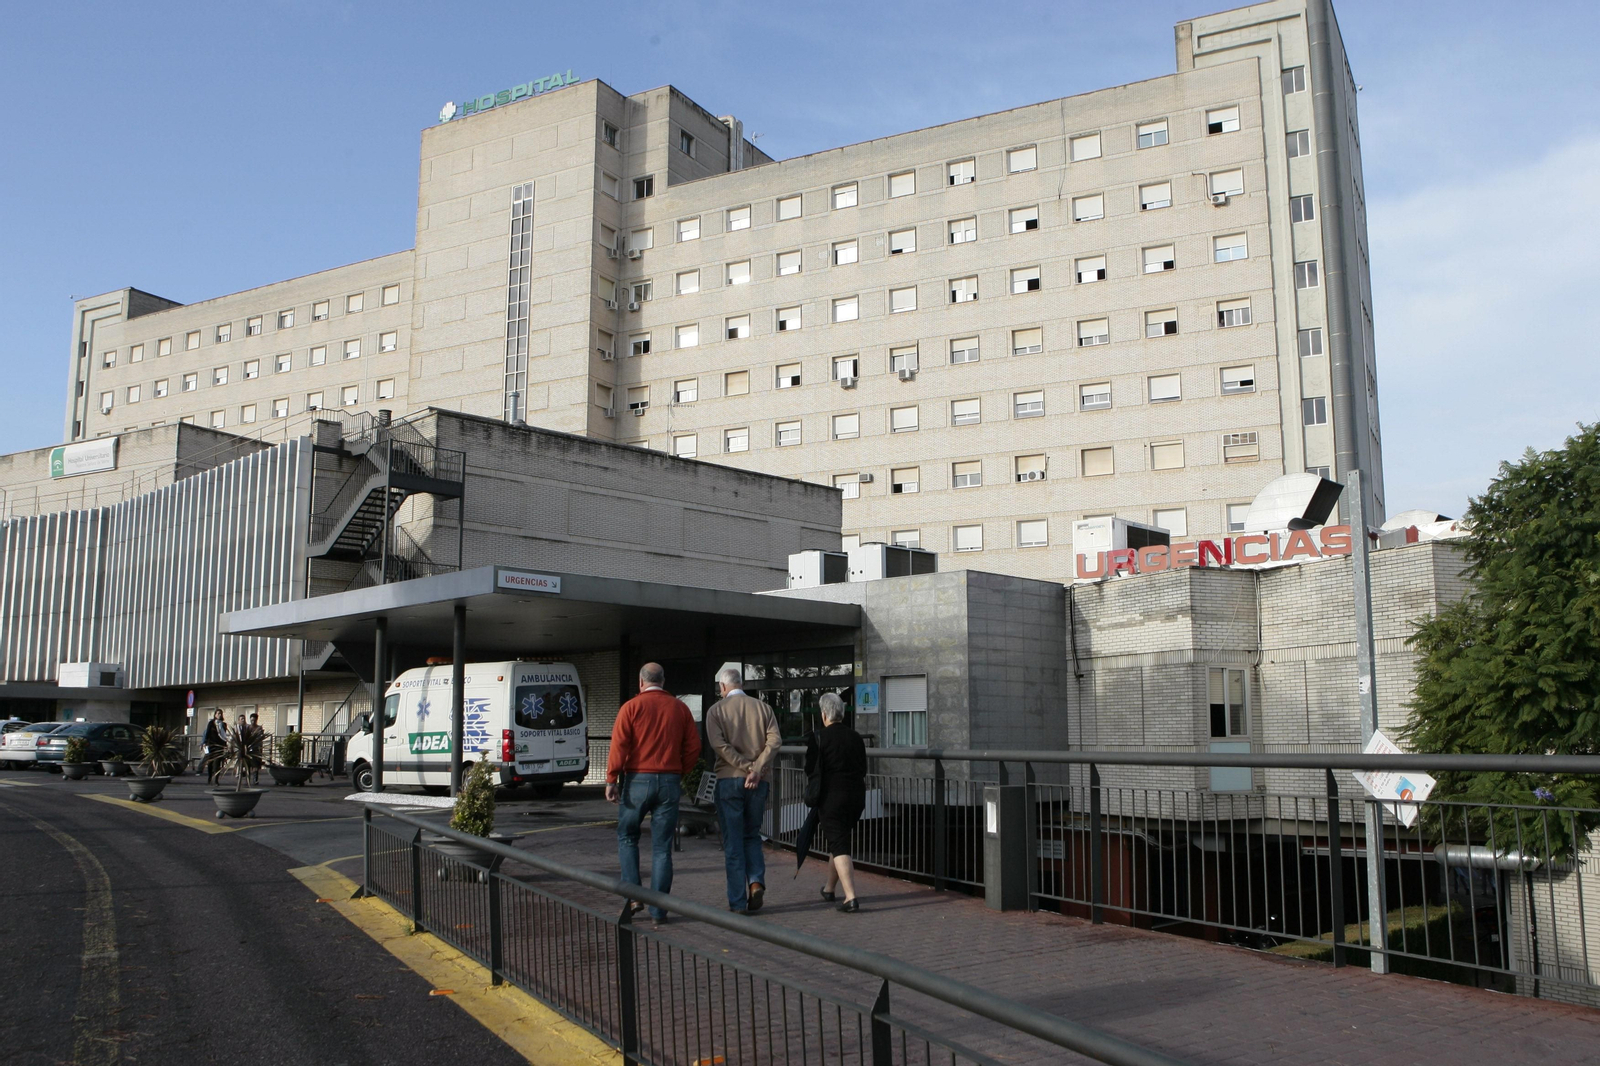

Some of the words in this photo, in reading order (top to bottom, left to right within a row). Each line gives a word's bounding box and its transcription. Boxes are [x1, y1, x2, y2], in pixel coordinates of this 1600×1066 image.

[462, 69, 580, 116] HOSPITAL
[1076, 524, 1352, 578] URGENCIAS
[505, 575, 548, 587] URGENCIAS
[402, 679, 426, 688] SOPORTE
[521, 674, 573, 683] AMBULANCIA
[520, 730, 546, 738] SOPORTE
[547, 729, 562, 737] VITAL
[412, 733, 449, 751] ADEA
